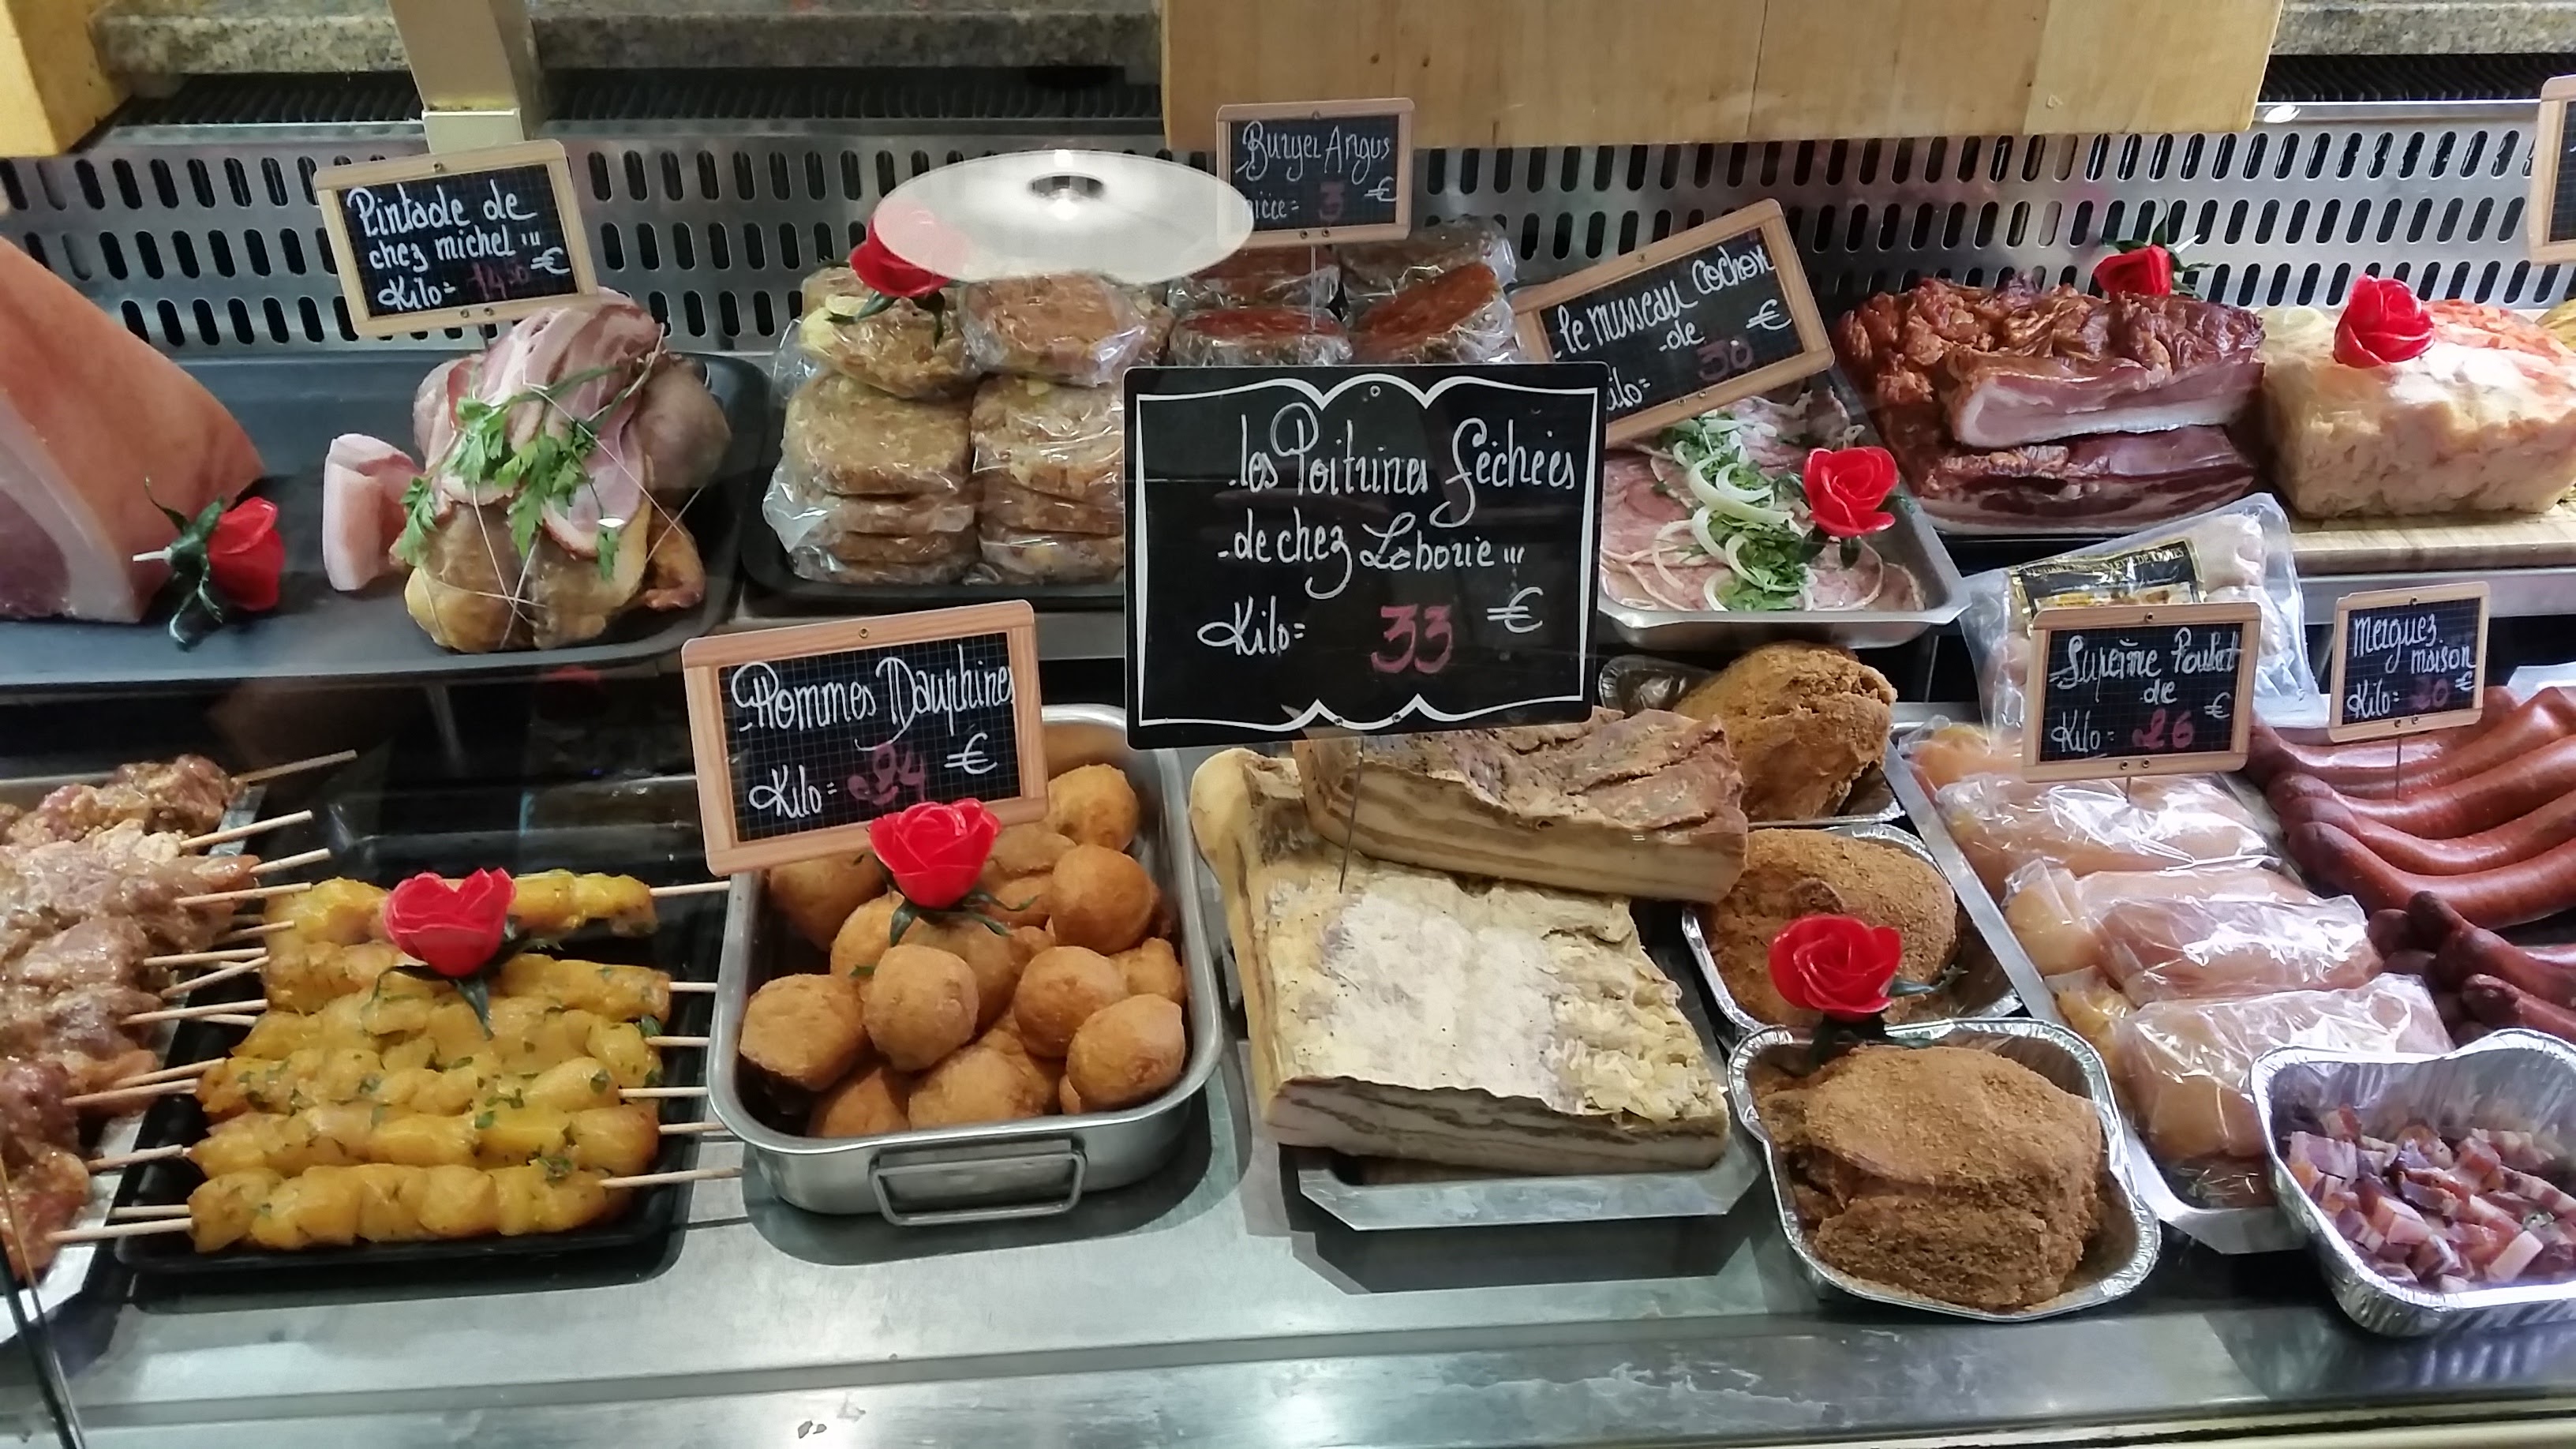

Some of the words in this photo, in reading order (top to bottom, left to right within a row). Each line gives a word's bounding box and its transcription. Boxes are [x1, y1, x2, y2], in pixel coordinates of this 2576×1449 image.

[1324, 125, 1390, 185] Angus
[346, 183, 471, 238] Pintade
[483, 178, 538, 221] de
[369, 239, 430, 272] chez
[1370, 604, 1453, 673] 33
[1487, 586, 1544, 633] €
[944, 732, 998, 775] €
